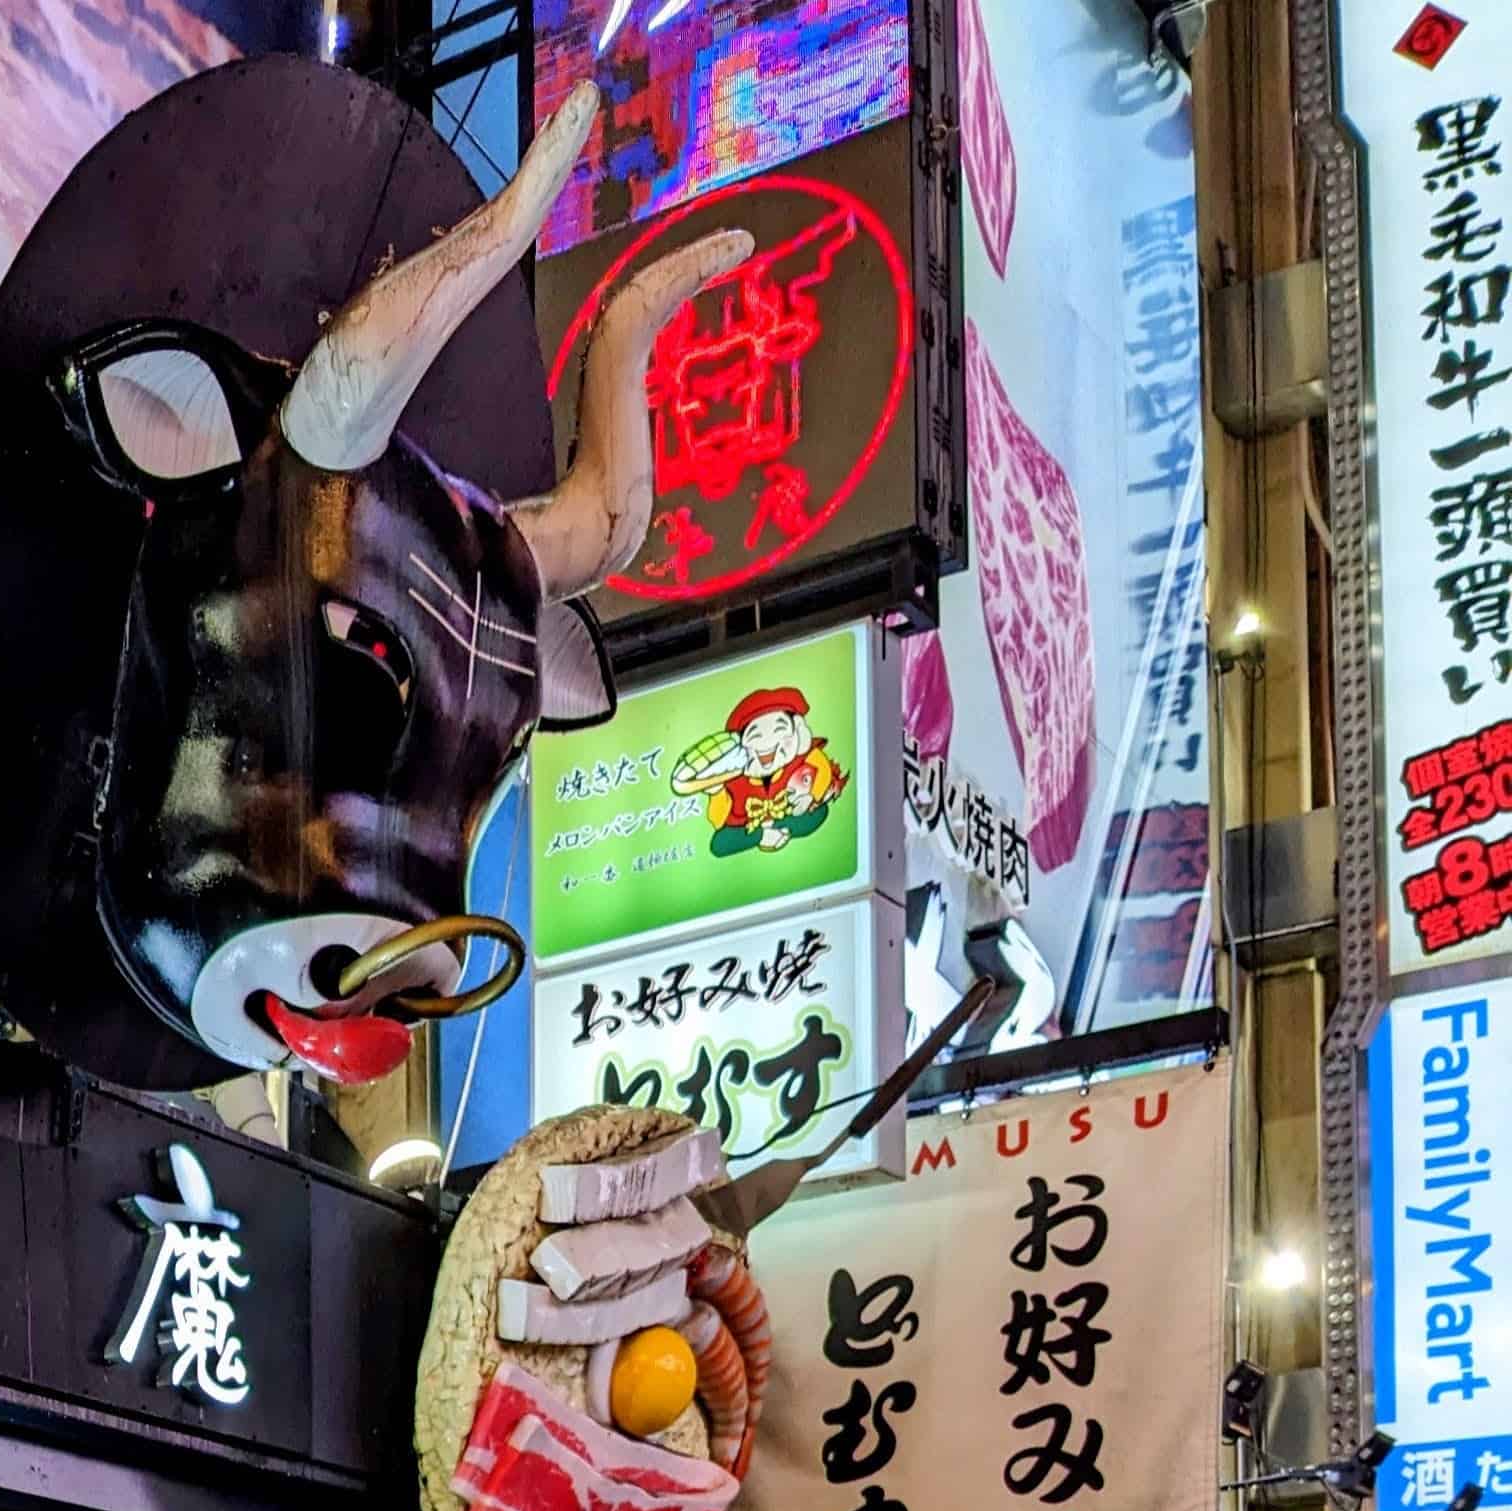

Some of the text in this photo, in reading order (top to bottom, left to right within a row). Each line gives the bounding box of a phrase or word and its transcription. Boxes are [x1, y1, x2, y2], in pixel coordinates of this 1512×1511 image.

[556, 747, 665, 802] 焼きたて
[572, 928, 832, 1047] お好み焼
[1405, 998, 1492, 1405] FamilyMart
[1400, 1450, 1456, 1506] 酒
